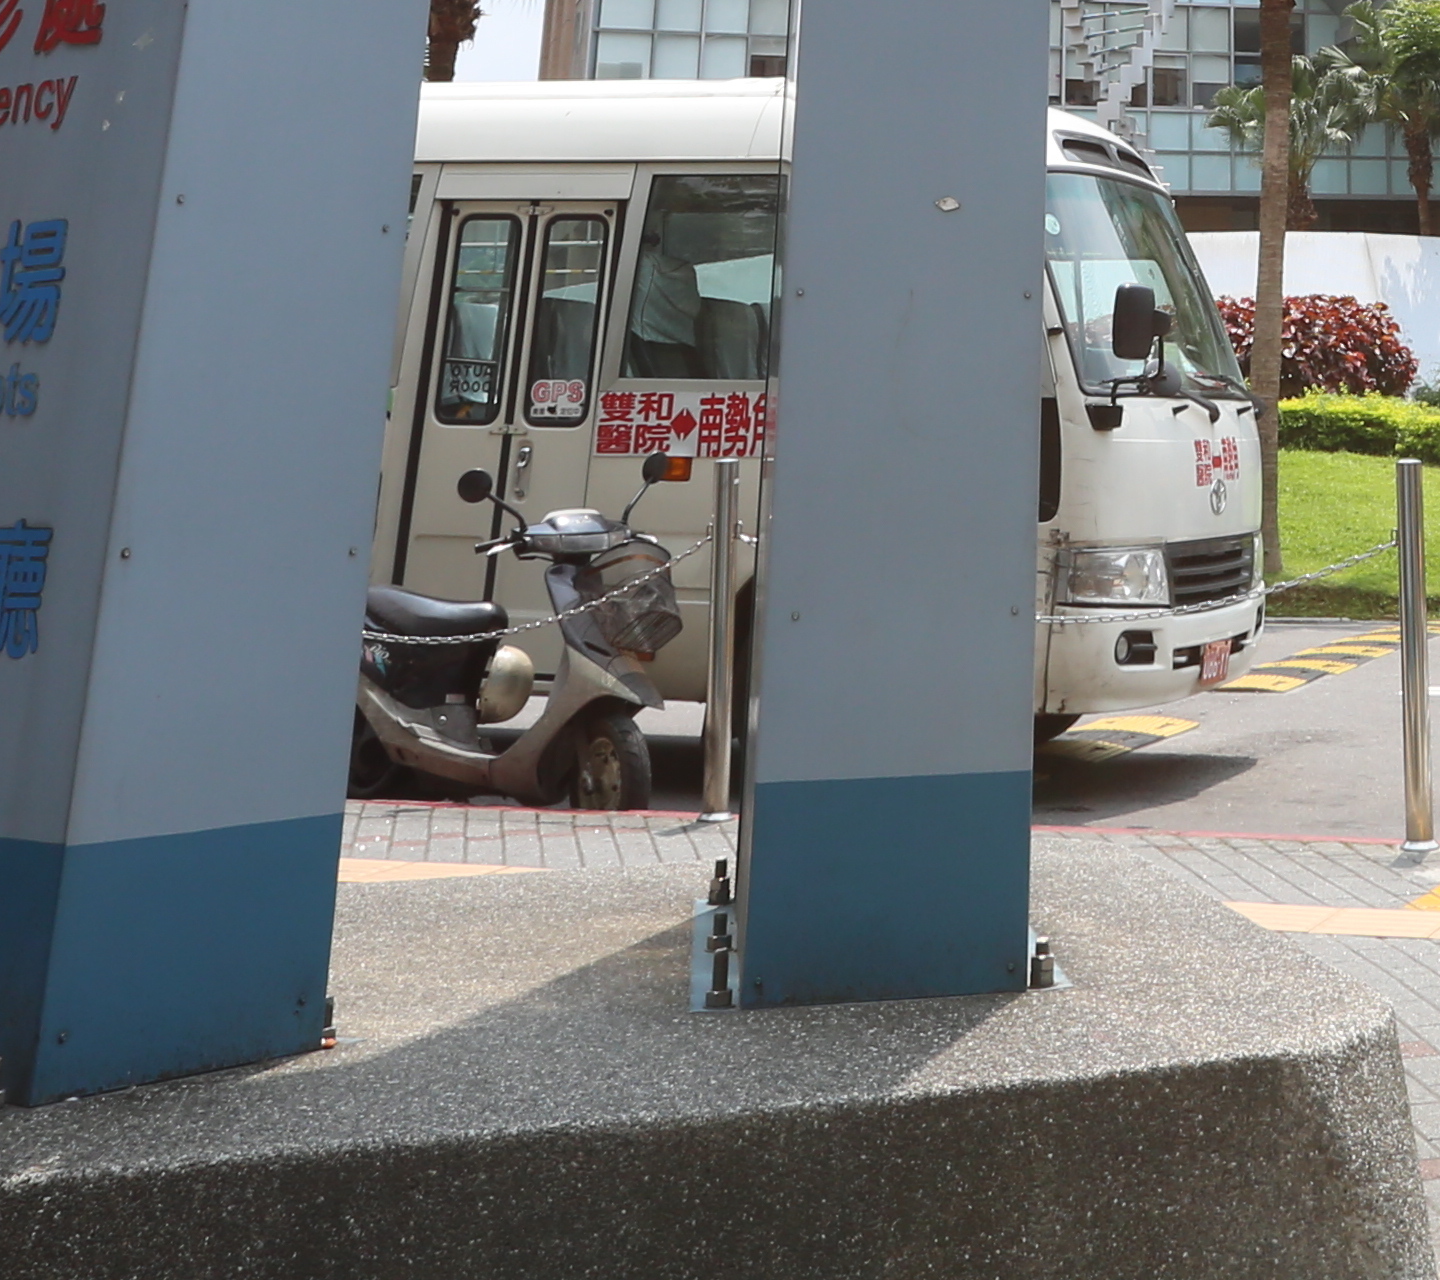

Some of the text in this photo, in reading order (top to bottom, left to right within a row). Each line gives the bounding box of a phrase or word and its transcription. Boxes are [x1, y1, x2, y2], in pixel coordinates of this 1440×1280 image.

[532, 381, 584, 404] GPS
[599, 391, 675, 423] 雙和
[596, 423, 672, 454] 醫院
